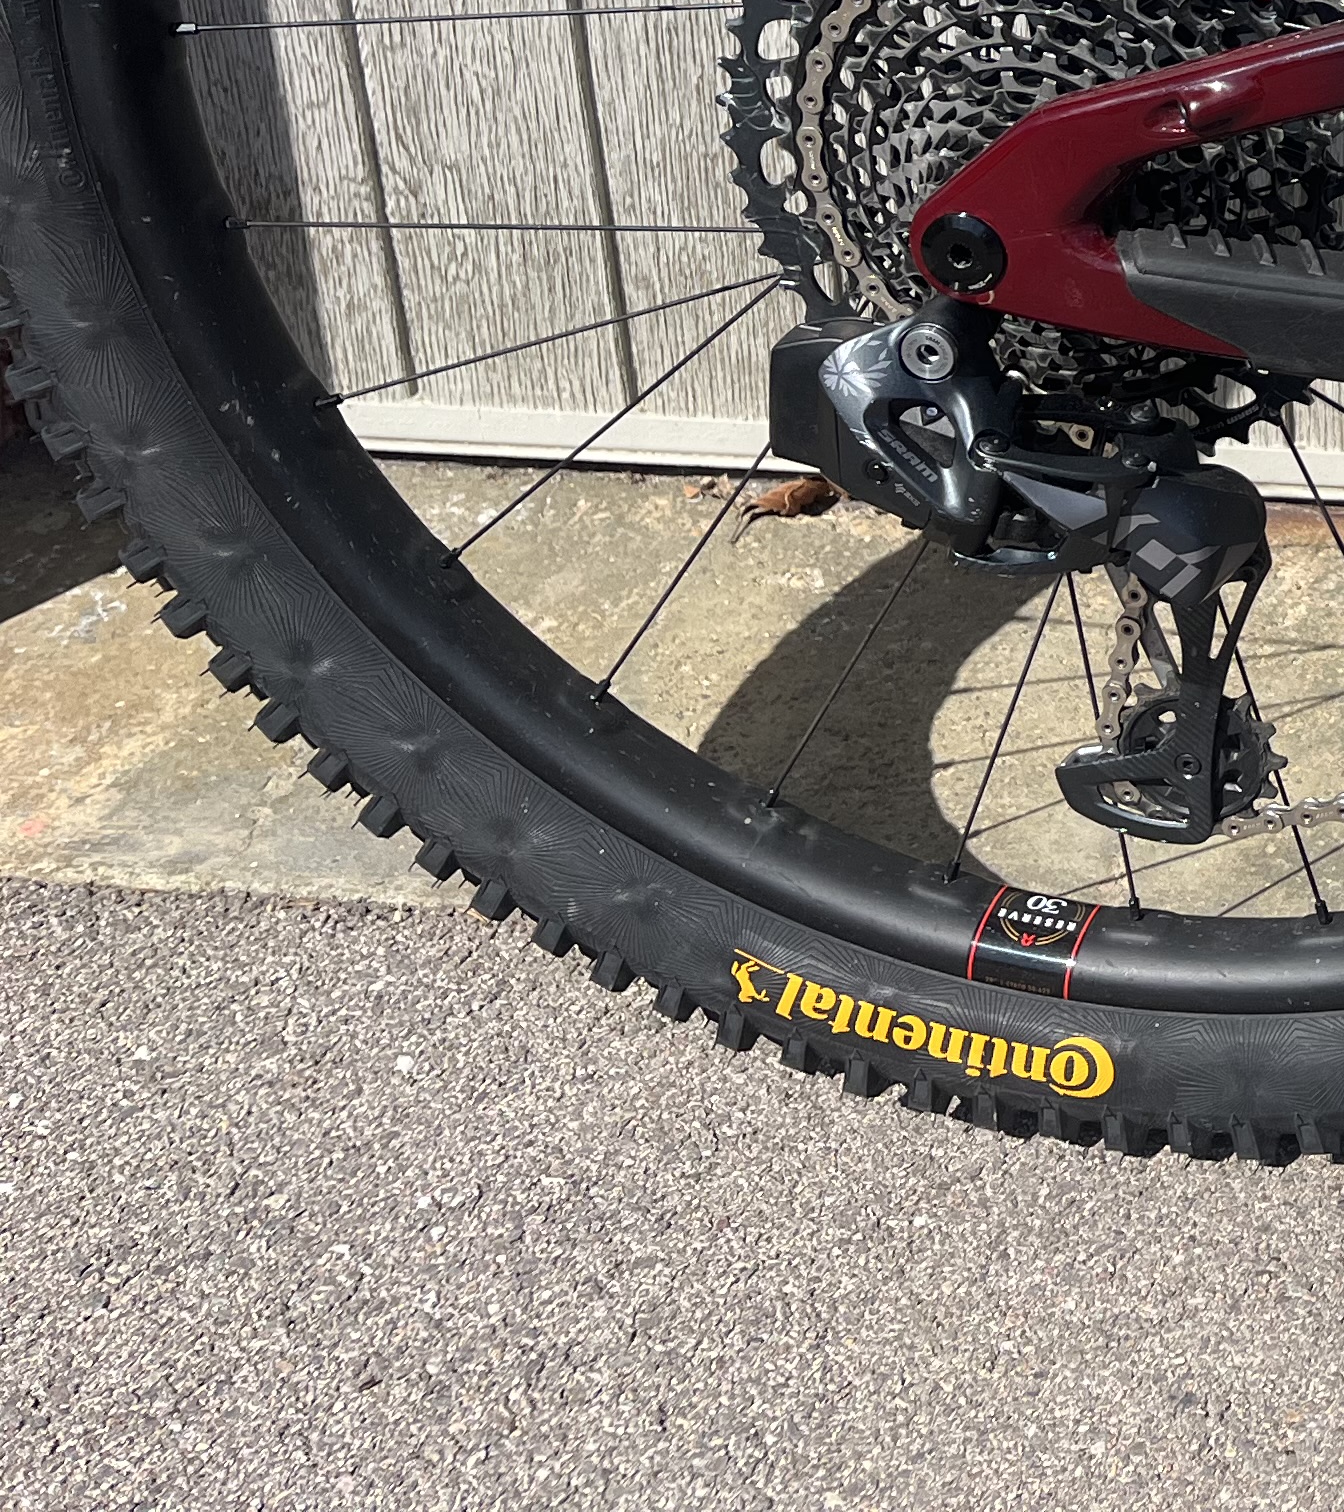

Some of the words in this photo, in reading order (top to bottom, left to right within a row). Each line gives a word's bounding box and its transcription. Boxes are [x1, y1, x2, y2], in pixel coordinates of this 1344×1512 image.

[876, 428, 939, 483] SRAM
[997, 907, 1077, 932] RESERVE
[1025, 895, 1068, 915] 30
[773, 971, 1115, 1099] Continental
